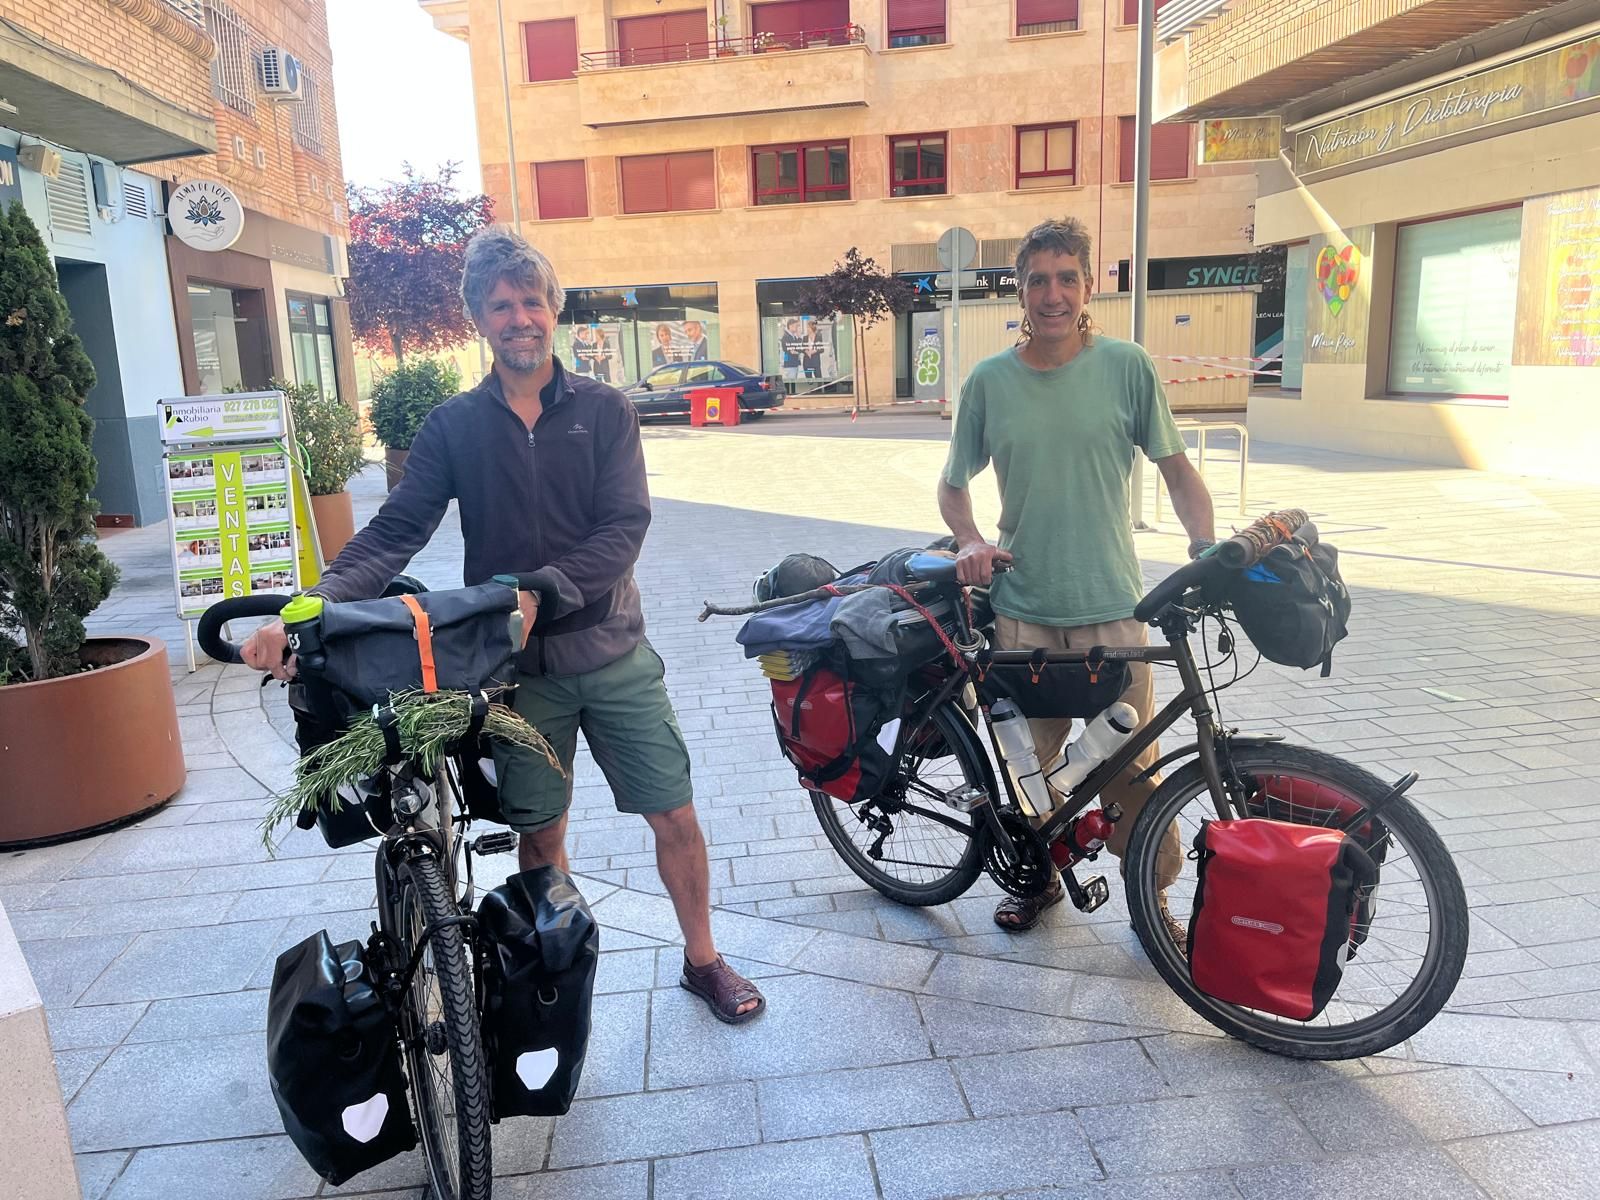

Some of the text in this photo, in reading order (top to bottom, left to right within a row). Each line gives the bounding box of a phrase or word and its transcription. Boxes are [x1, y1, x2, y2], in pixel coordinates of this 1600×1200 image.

[1305, 84, 1522, 162] Nutrición y Dietoterapia
[183, 414, 209, 423] Rubio
[220, 463, 245, 598] VENTAS
